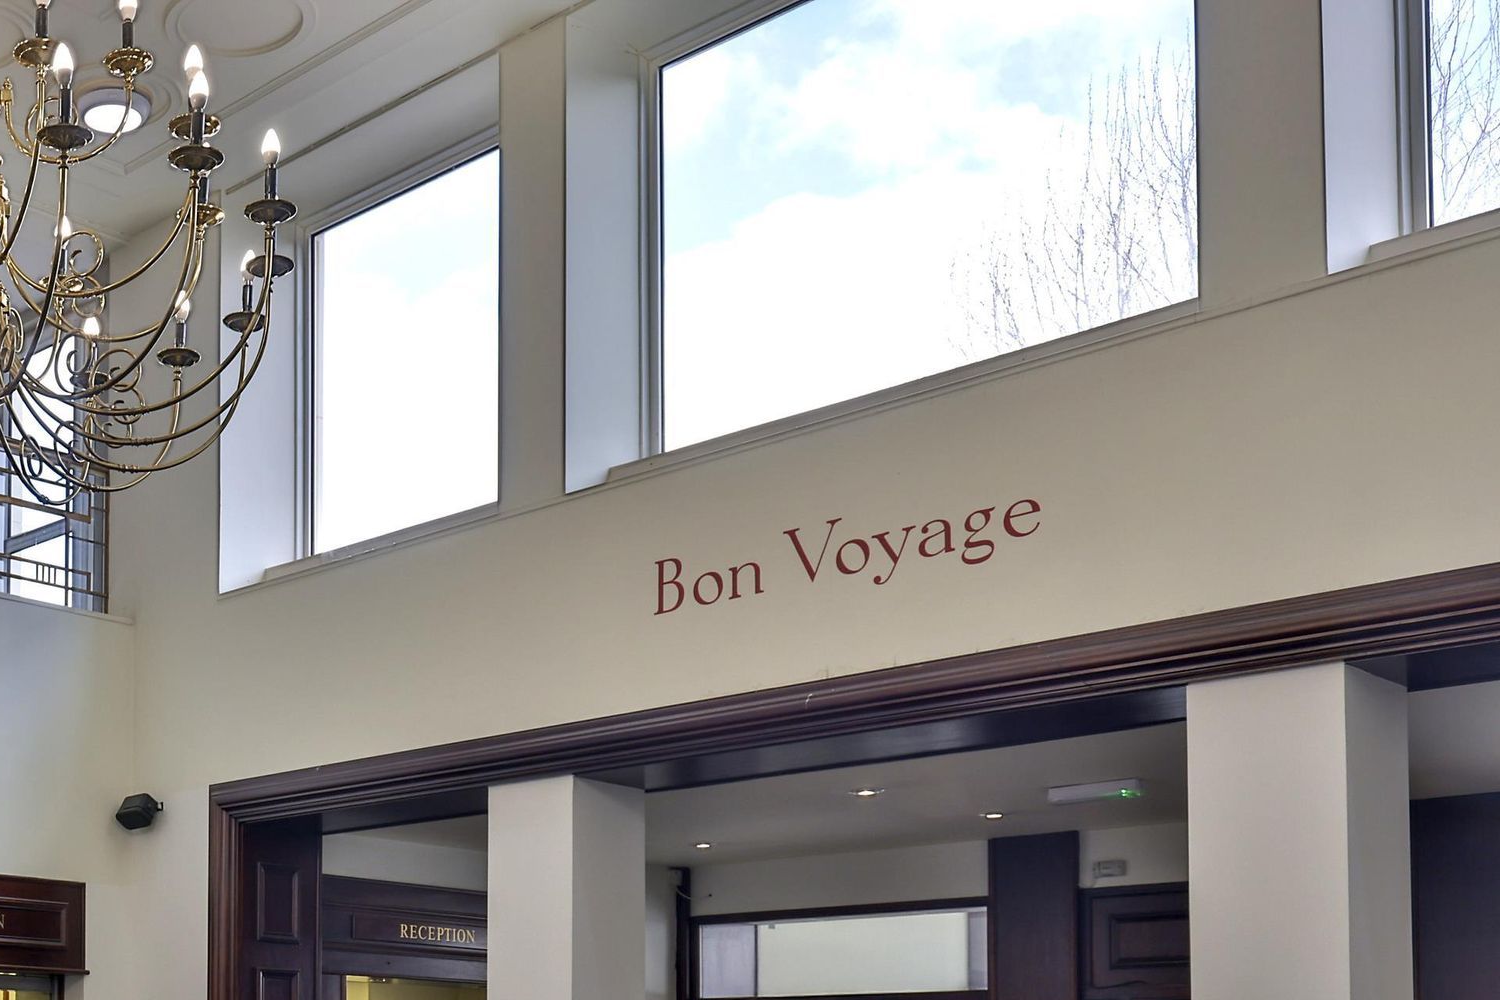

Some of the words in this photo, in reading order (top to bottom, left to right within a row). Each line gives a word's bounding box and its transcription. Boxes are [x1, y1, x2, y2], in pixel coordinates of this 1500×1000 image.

[653, 557, 764, 616] Bon
[782, 498, 1041, 586] Voyage
[399, 923, 476, 943] RECEPTION
